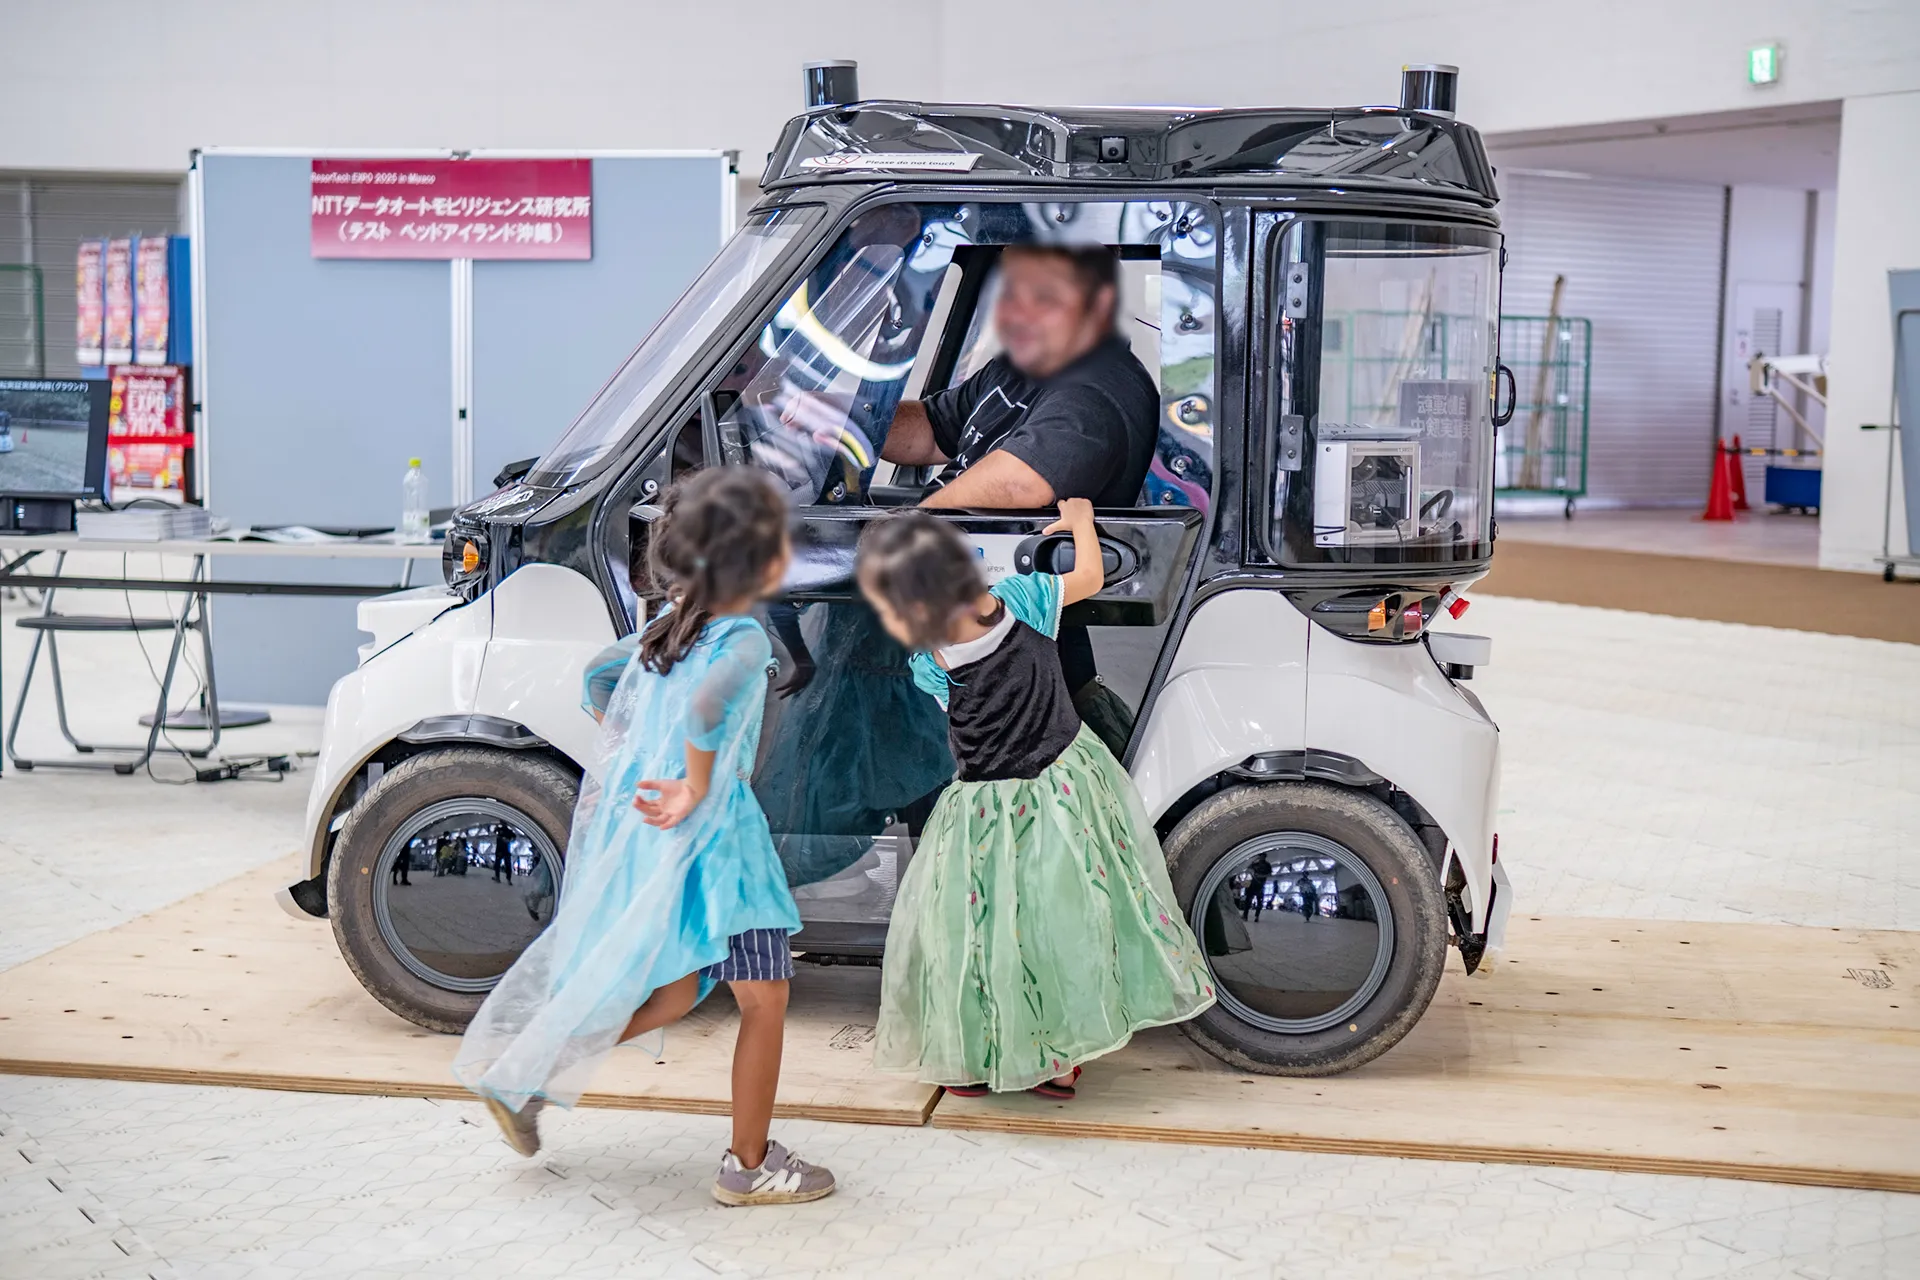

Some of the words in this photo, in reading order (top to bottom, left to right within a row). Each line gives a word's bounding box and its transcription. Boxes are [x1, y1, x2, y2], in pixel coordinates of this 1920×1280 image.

[351, 172, 373, 184] EXPO
[374, 173, 397, 184] 2025
[398, 174, 407, 184] in
[312, 195, 590, 217] NTTデータオートモビリジェンス研究所
[127, 390, 166, 414] EXPO
